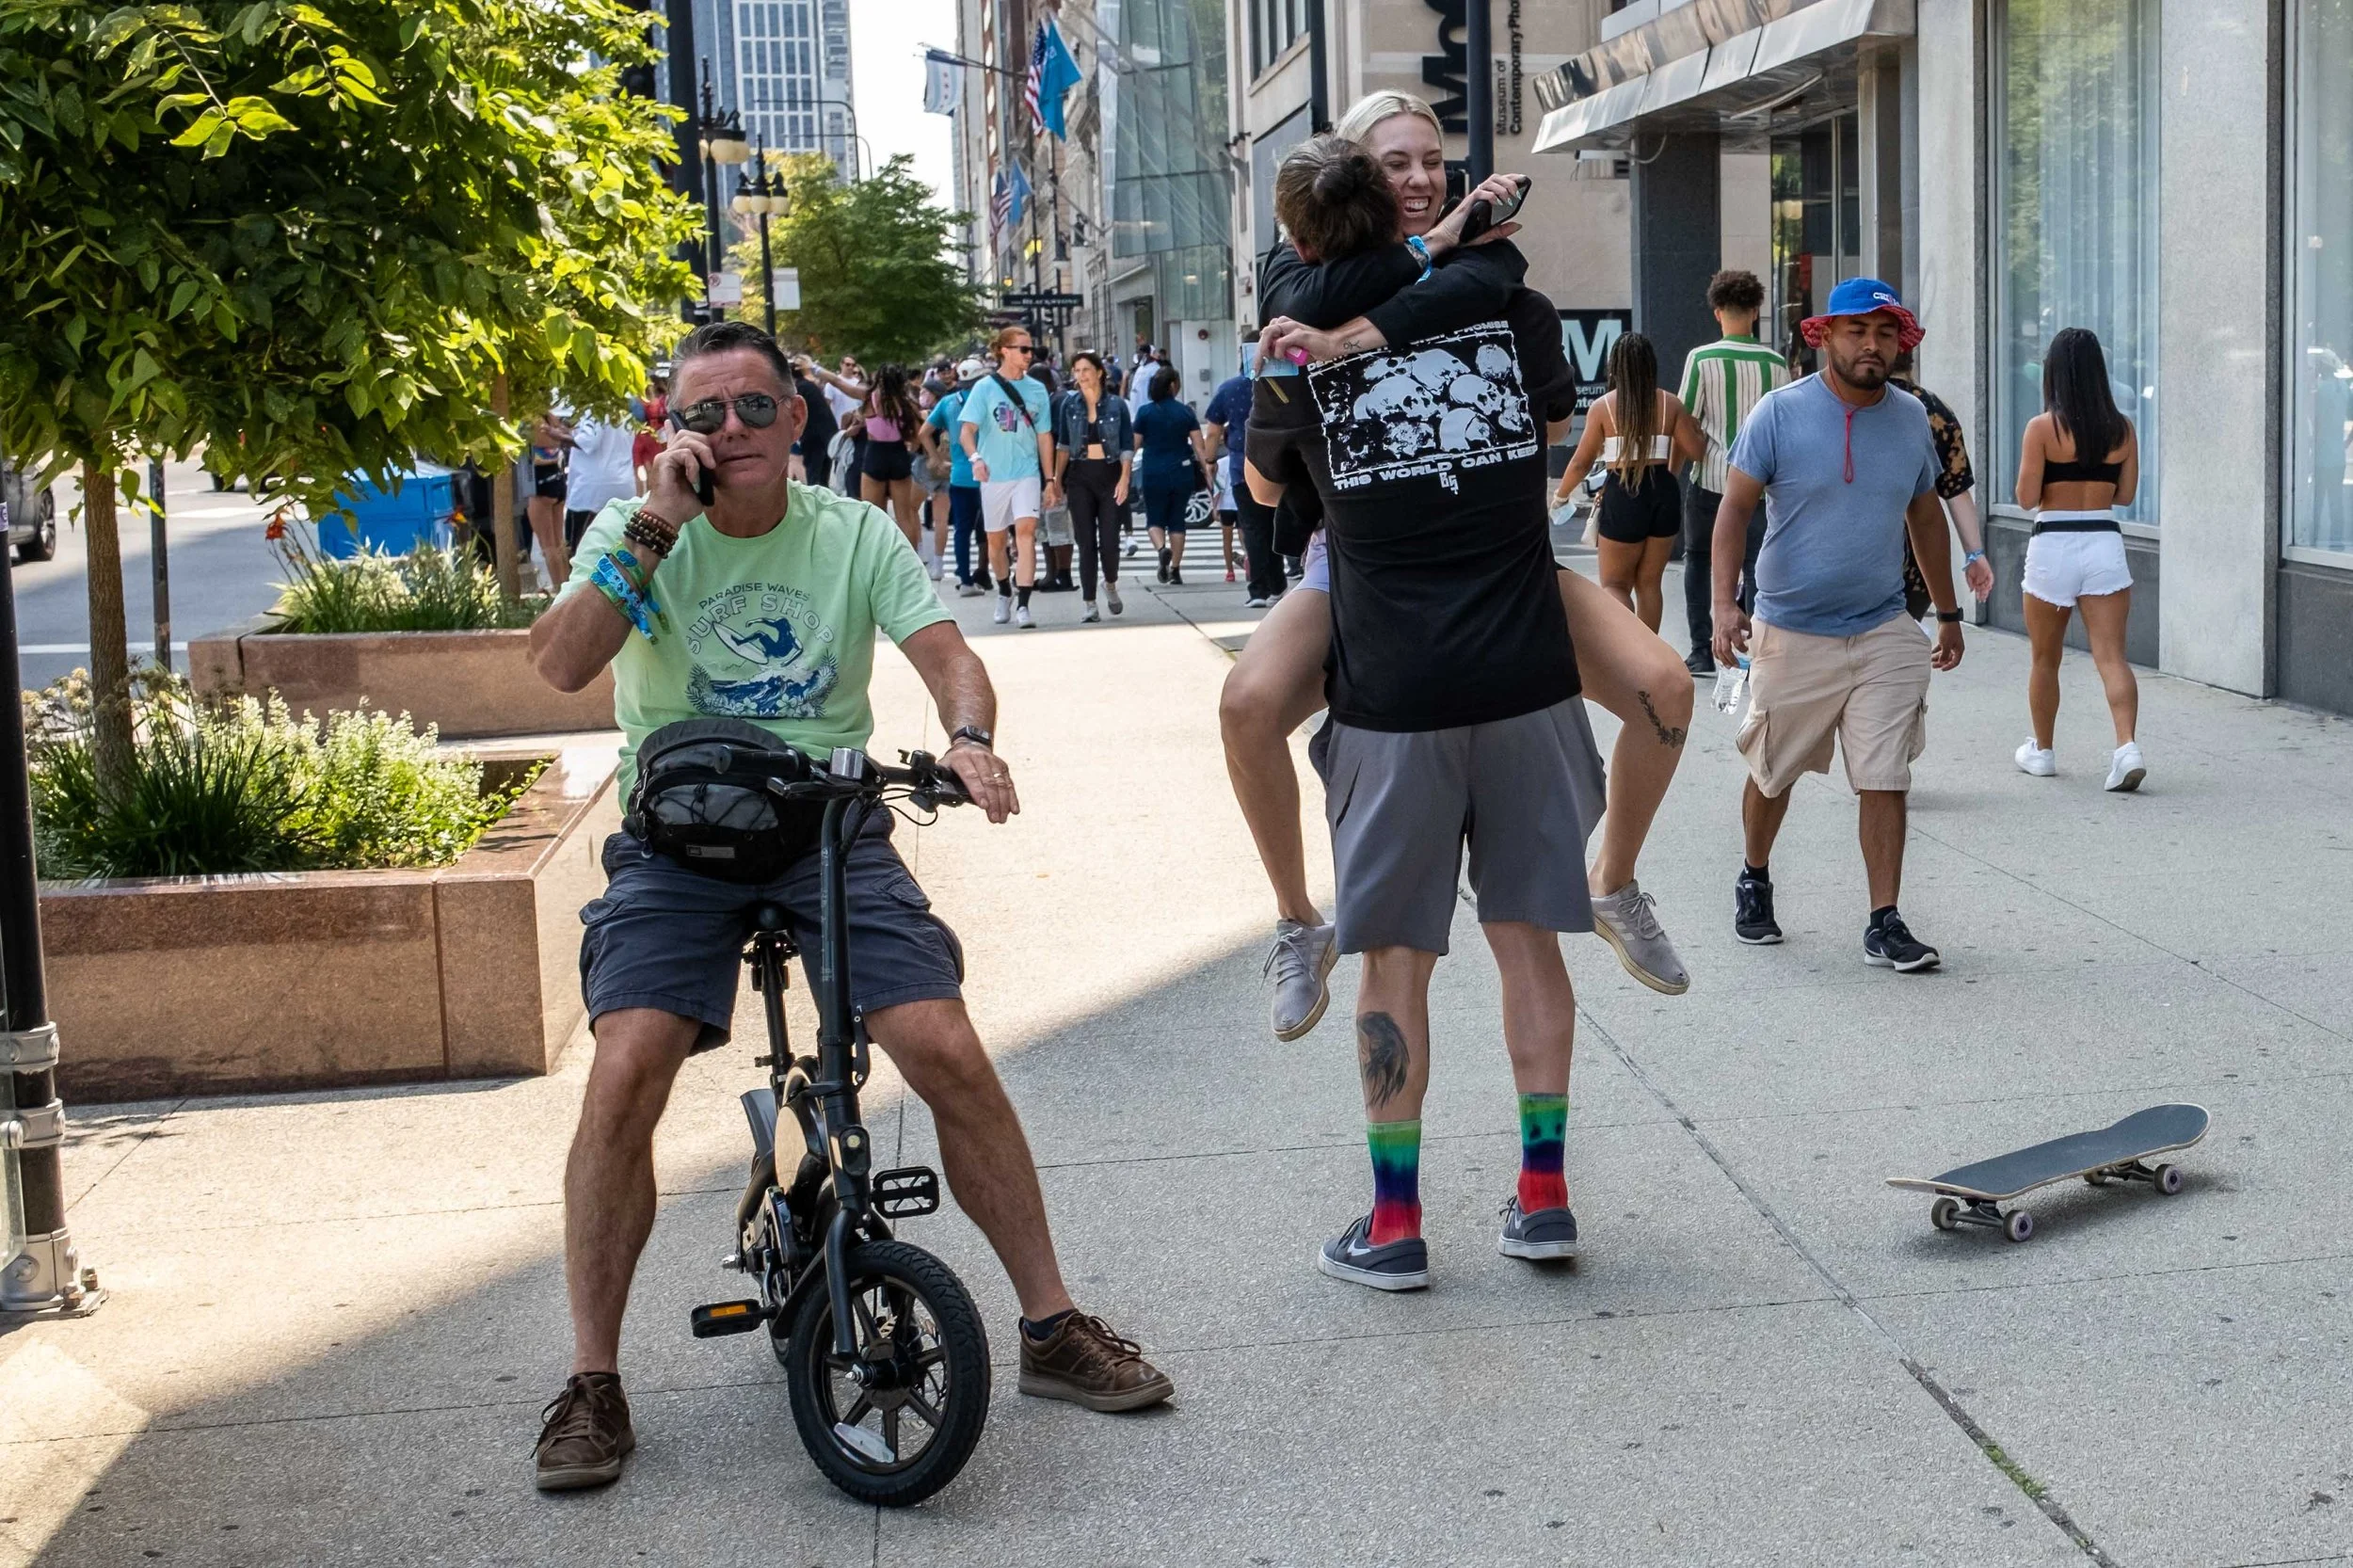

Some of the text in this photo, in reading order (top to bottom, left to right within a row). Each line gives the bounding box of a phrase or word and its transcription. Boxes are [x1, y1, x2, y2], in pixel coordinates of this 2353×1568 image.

[1496, 59, 1507, 136] Museum of
[1510, 31, 1524, 135] Contemporary
[1333, 474, 1372, 490] THIS
[1379, 461, 1453, 481] WORLD
[686, 593, 835, 655] SURF SHOP
[698, 582, 810, 610] PARADISE WAVES
